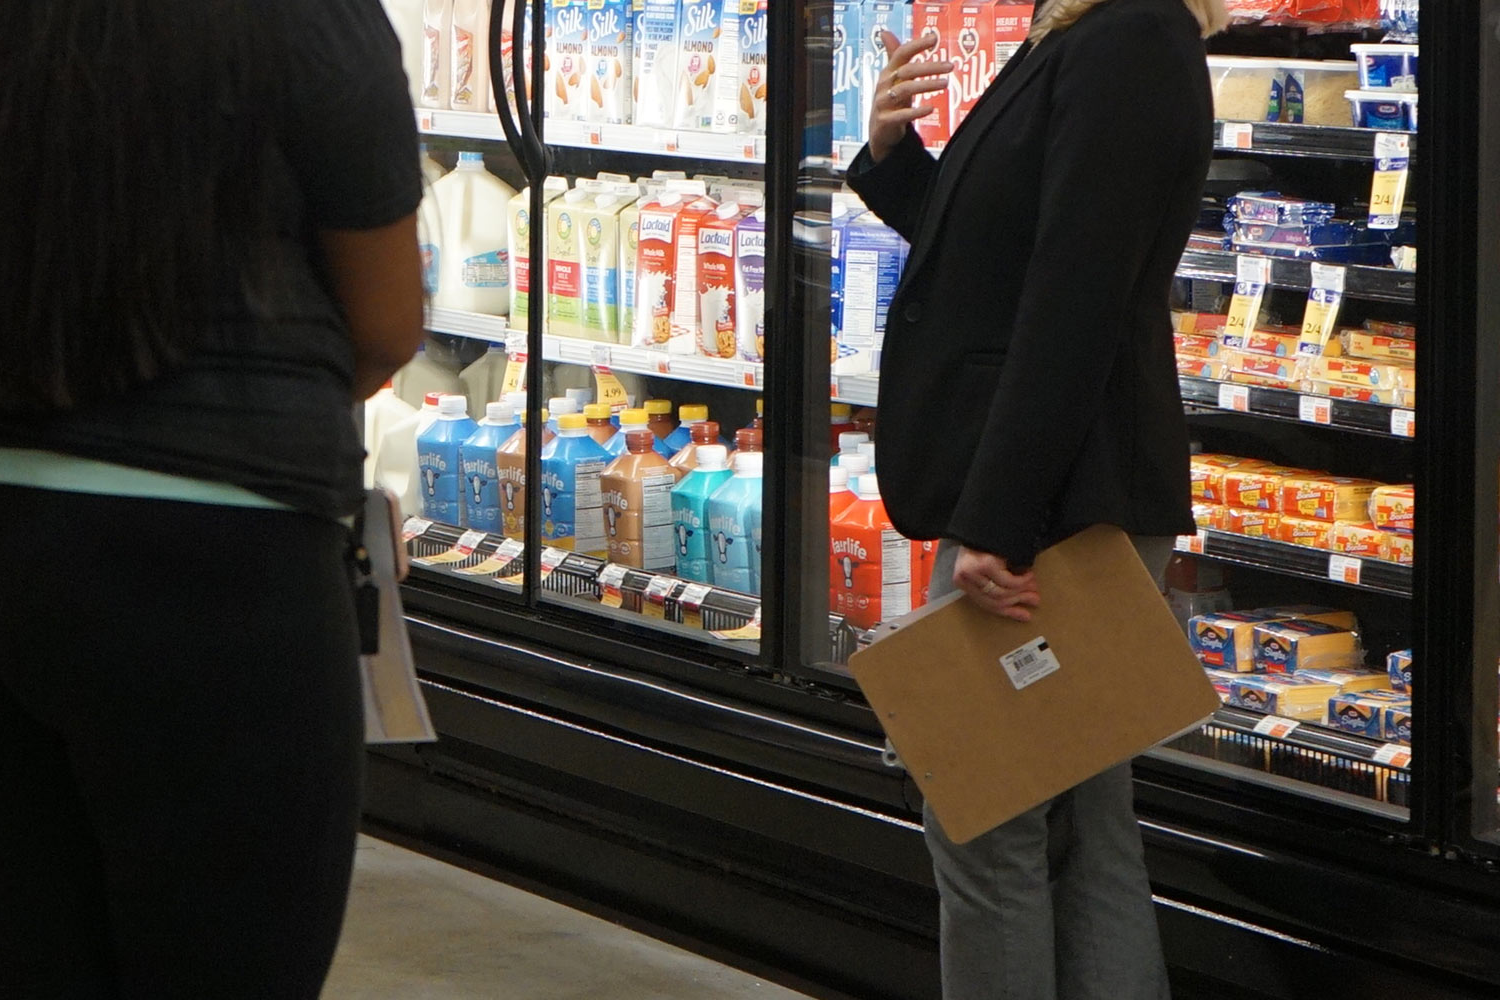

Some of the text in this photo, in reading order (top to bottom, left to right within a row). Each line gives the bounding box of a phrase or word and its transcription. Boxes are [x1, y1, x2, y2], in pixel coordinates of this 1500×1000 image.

[556, 5, 585, 39] Silk
[591, 7, 620, 42] Silk
[684, 2, 717, 38] Silk
[876, 14, 888, 24] SOY
[926, 16, 938, 26] SOY
[963, 17, 976, 27] SOY
[996, 17, 1018, 26] HEART
[556, 42, 583, 55] ALMOND
[591, 45, 618, 57] ALMOND
[684, 41, 714, 53] ALMOND
[950, 50, 996, 110] Silk
[642, 218, 670, 232] Lactaid
[700, 231, 731, 246] Lactaid
[556, 265, 572, 273] WHOLE
[604, 387, 621, 398] 4.99
[1238, 482, 1262, 492] Borden
[1296, 490, 1321, 500] Borden
[1293, 528, 1316, 537] Borden
[832, 537, 867, 560] fairlife
[1345, 543, 1368, 552] Borden
